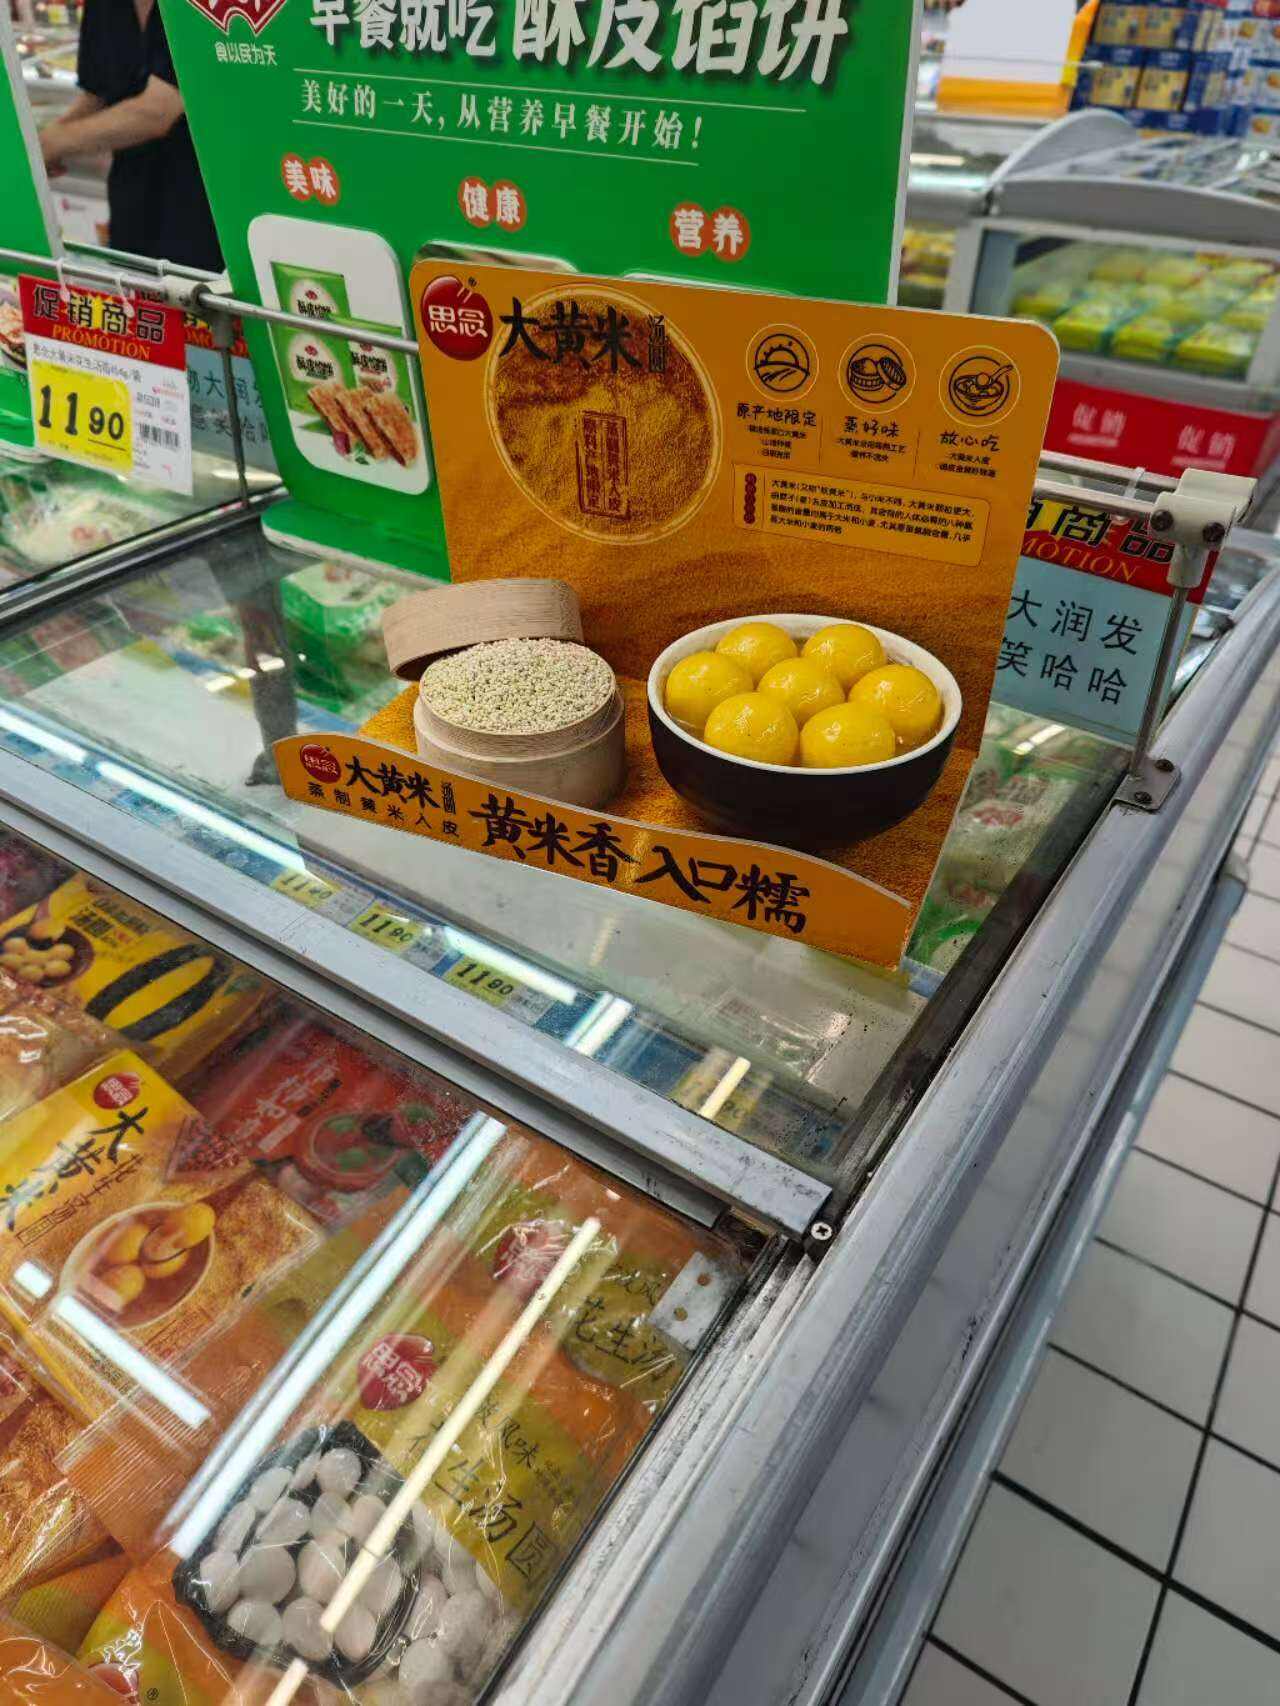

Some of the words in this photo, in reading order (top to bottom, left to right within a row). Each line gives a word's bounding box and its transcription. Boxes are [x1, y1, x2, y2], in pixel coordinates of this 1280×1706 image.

[283, 159, 337, 199] 美味
[461, 181, 521, 225] 健康
[673, 208, 744, 256] 营养
[32, 285, 166, 343] 促销商品
[428, 304, 488, 338] 思念
[499, 296, 643, 374] 大黄米
[51, 325, 152, 361] PROMOTION
[736, 402, 817, 427] 原产地限定
[843, 415, 900, 438] 蒸好味
[939, 430, 1000, 452] 放心吃
[1007, 589, 1143, 655] 大润发
[996, 637, 1127, 705] 笑哈哈
[345, 756, 441, 809] 大黄米
